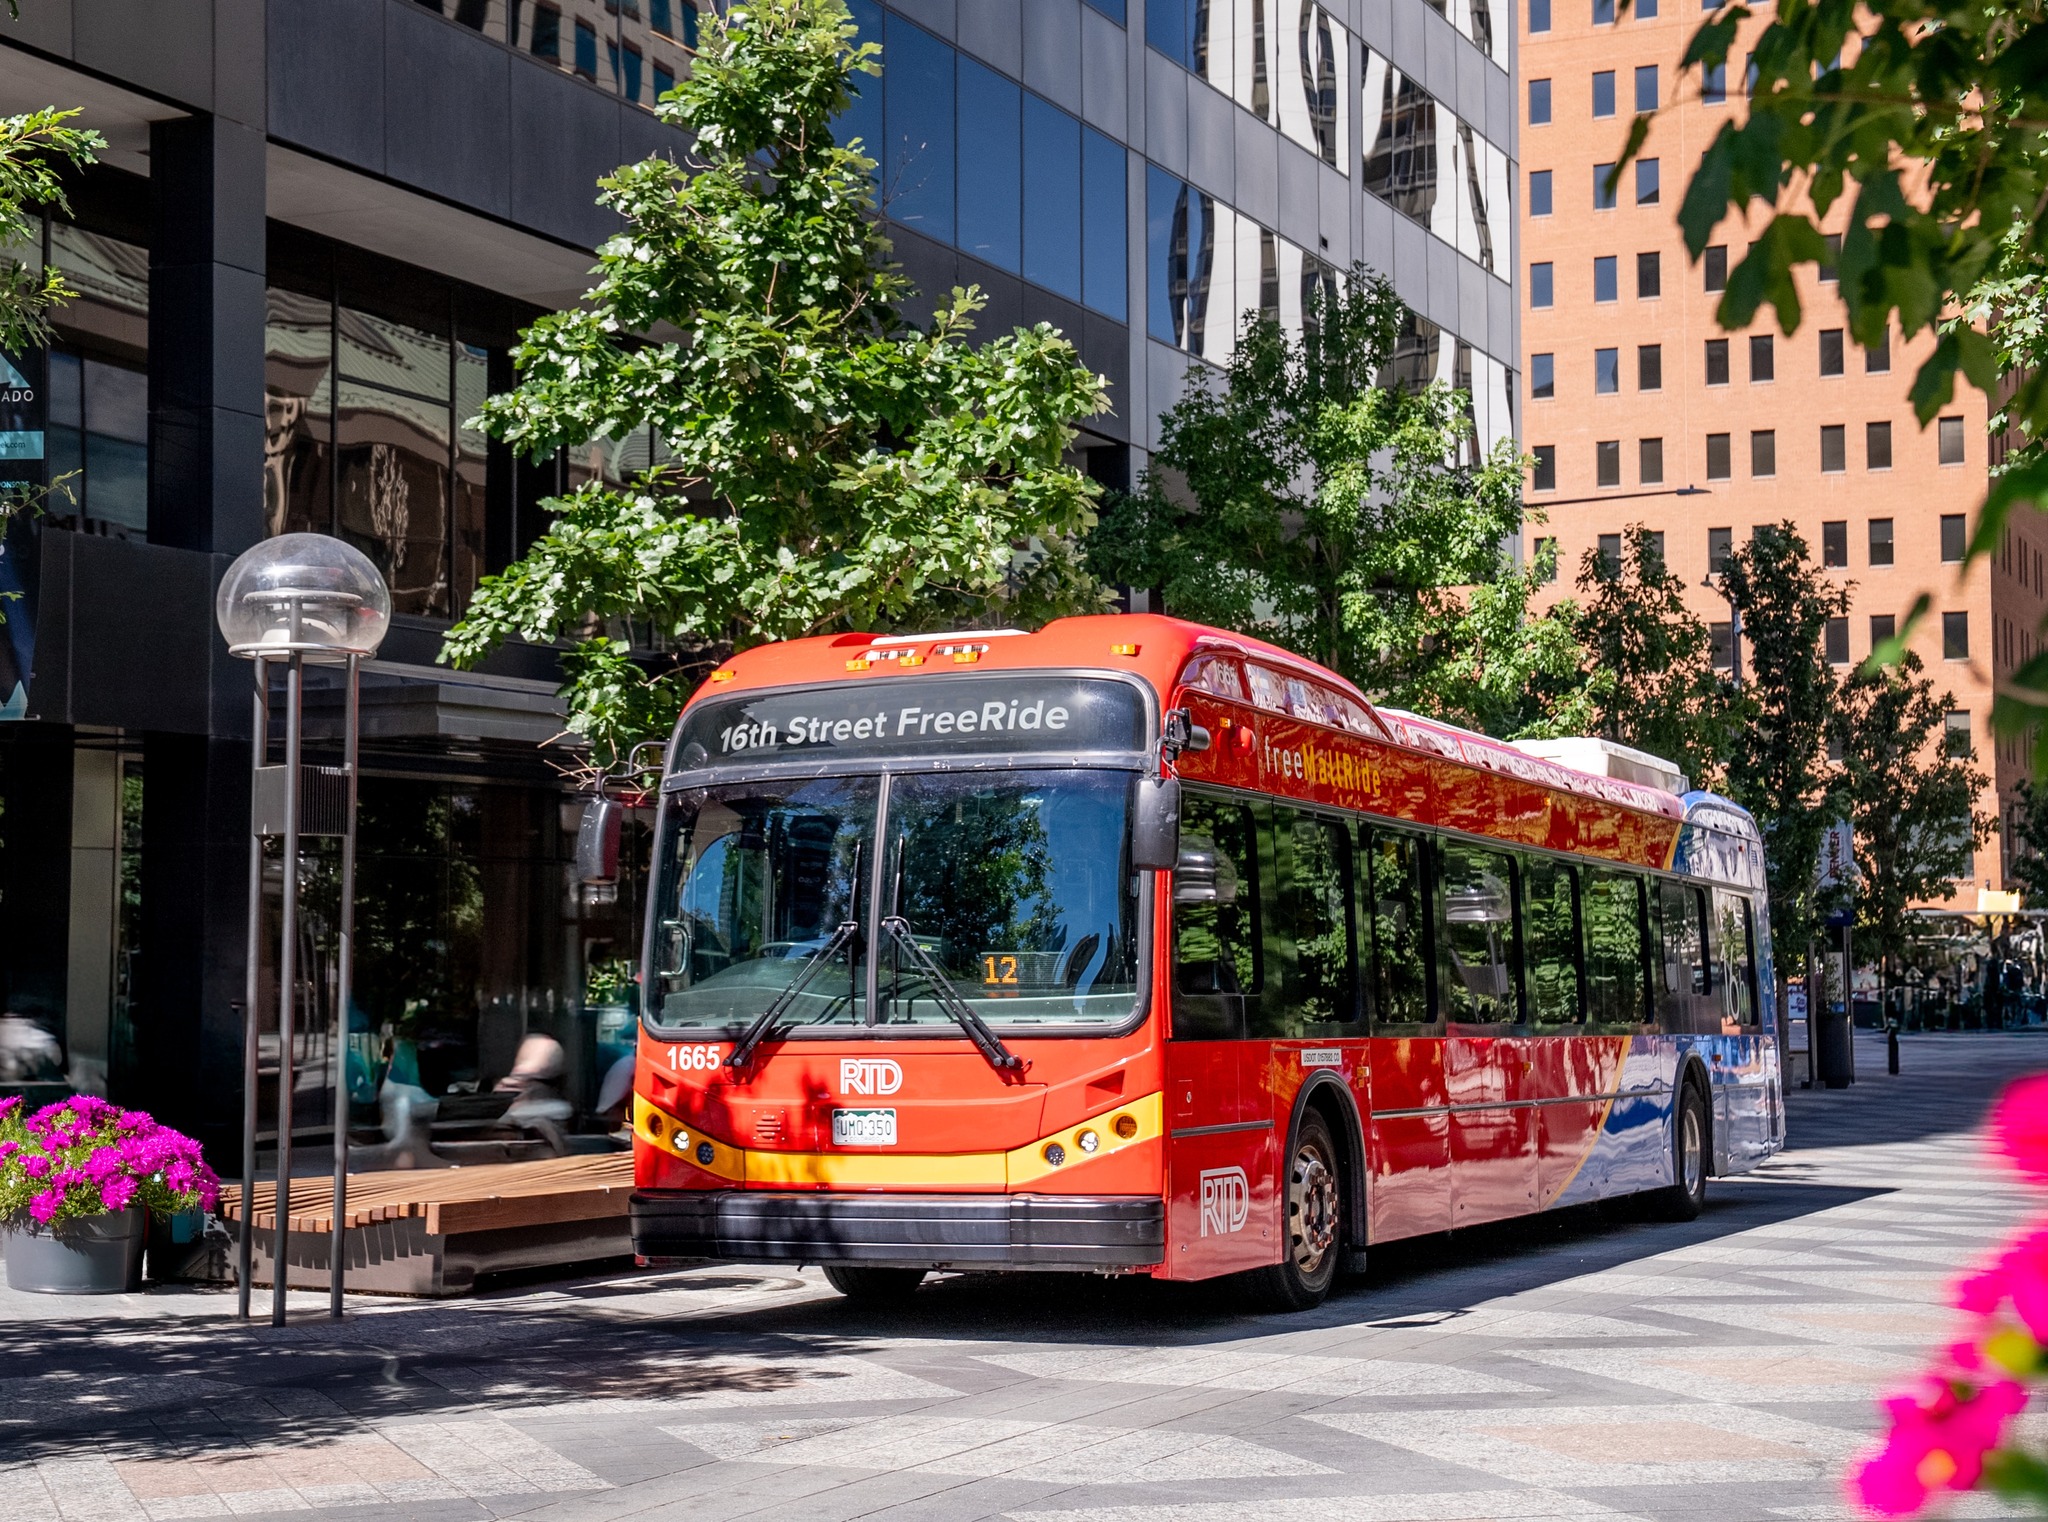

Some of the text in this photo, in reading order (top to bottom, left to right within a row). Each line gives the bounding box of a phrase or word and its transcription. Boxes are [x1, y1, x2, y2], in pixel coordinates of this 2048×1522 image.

[1213, 660, 1237, 687] 1665
[720, 699, 1070, 753] 16th Street FreeRide
[984, 956, 1018, 984] 12
[667, 1046, 720, 1071] 1665
[840, 1059, 903, 1095] RTD
[1200, 1166, 1249, 1238] RTD
